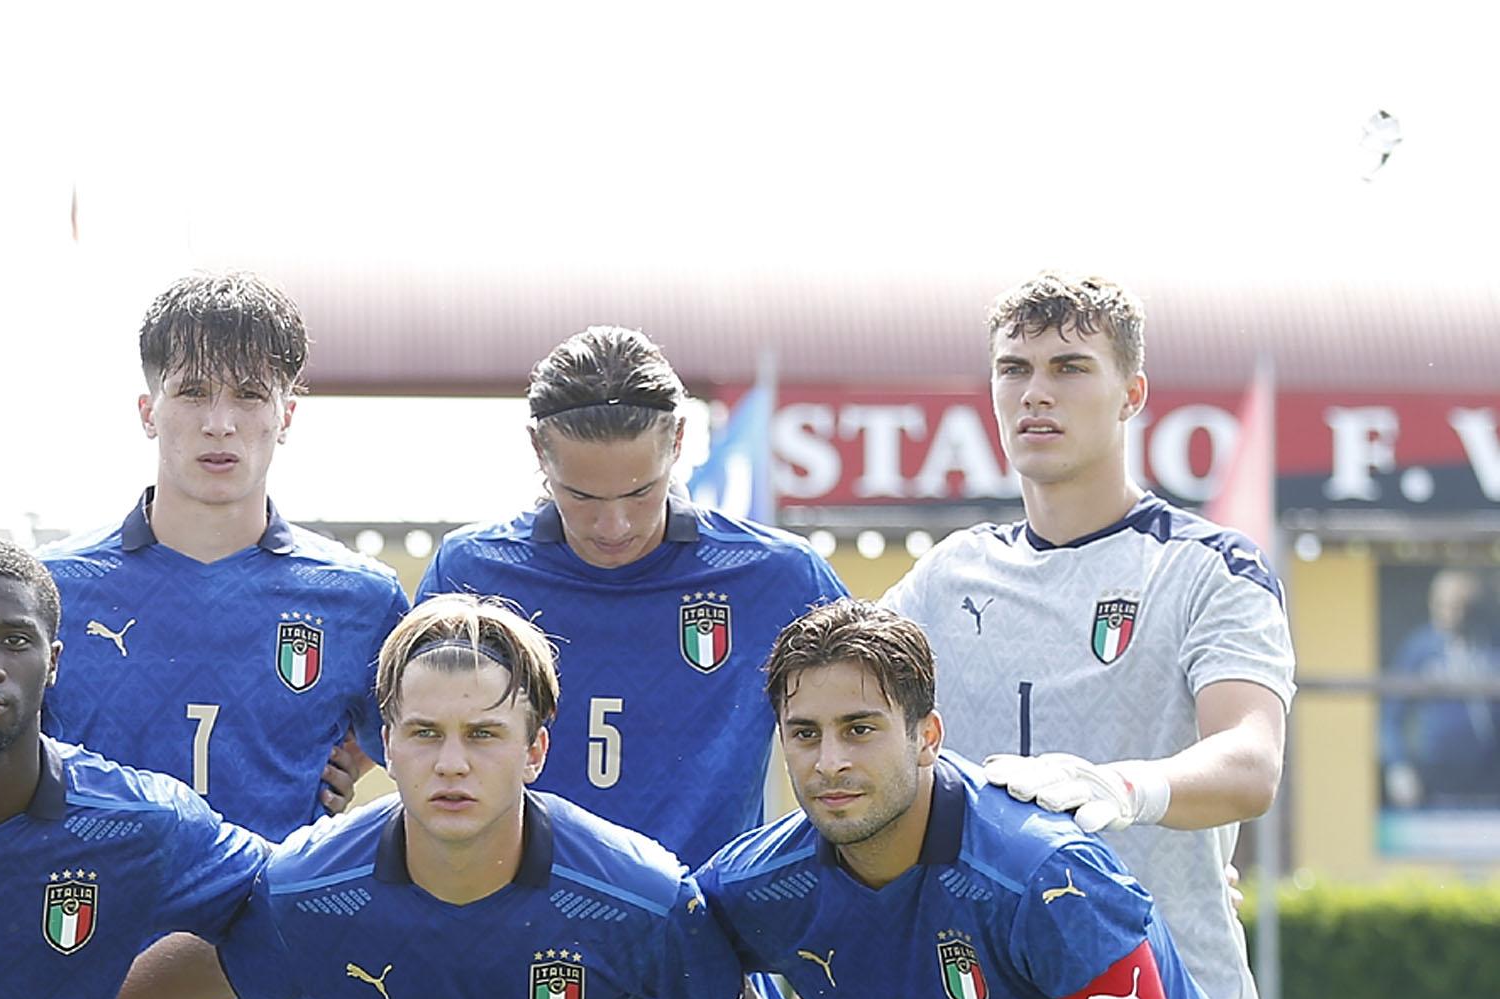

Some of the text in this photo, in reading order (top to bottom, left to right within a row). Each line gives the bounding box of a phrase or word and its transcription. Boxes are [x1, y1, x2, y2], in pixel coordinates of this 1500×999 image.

[771, 404, 1242, 500] STAIO
[1322, 405, 1435, 503] F.
[684, 607, 725, 620] ITALIA
[1099, 602, 1136, 614] ITALIA
[282, 627, 319, 641] ITALIA
[1018, 681, 1033, 757] 1
[186, 703, 221, 796] 7
[588, 697, 624, 789] 5
[50, 889, 93, 900] ITALIA
[943, 945, 977, 961] ITALIA
[536, 967, 580, 980] ITALIA
